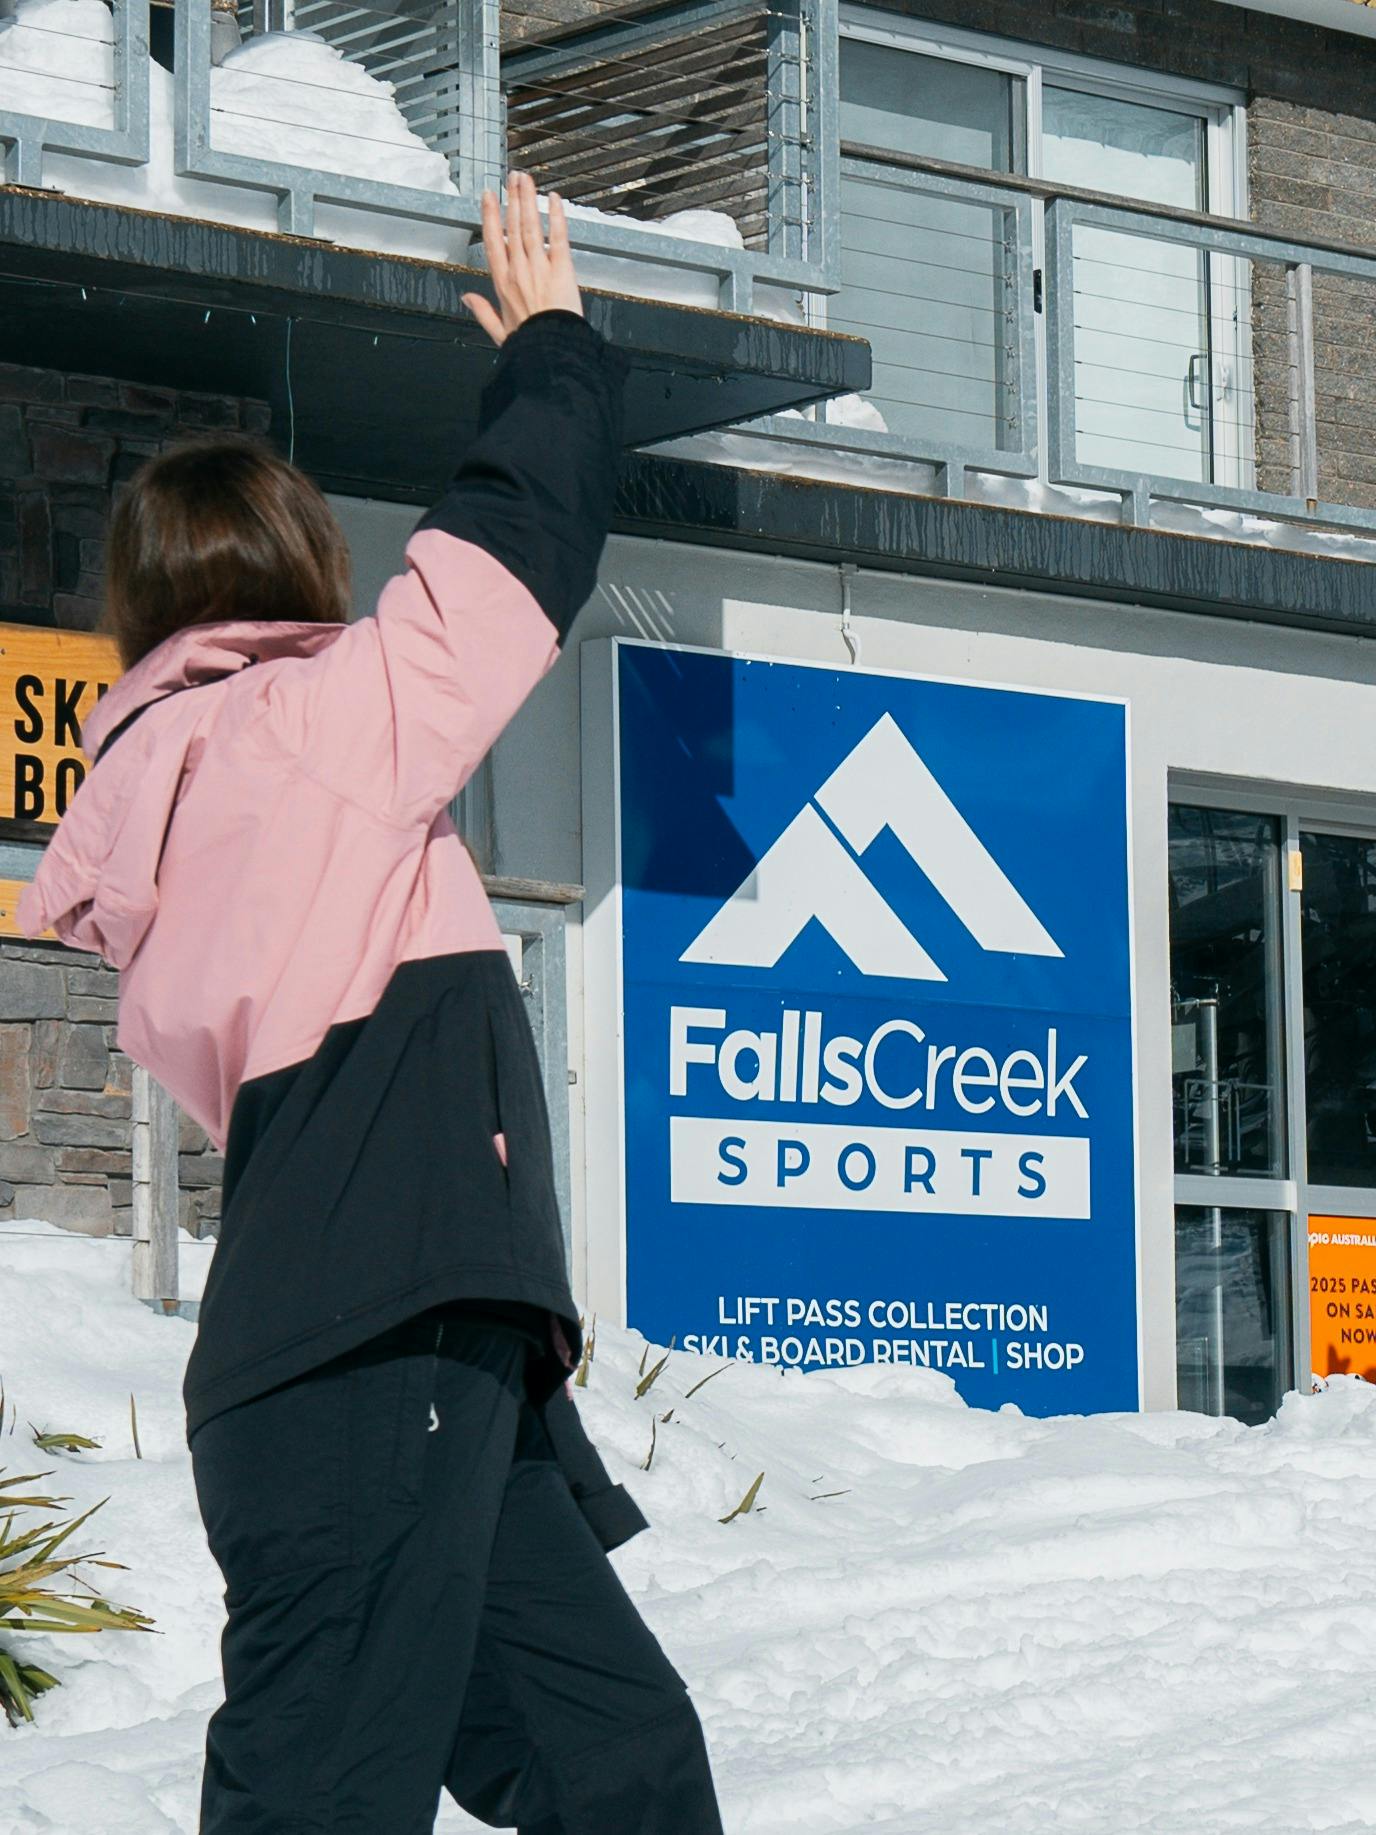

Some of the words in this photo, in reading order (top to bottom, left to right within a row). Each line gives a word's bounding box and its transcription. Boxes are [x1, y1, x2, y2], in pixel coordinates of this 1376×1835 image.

[14, 674, 108, 749] SK
[669, 1005, 1090, 1119] FallsCreek
[716, 1135, 1048, 1199] SPORTS
[1311, 1276, 1346, 1293] 2025
[718, 1296, 779, 1325] LIFT
[787, 1298, 861, 1327] PASS
[868, 1301, 1048, 1332] COLLECTION
[1326, 1302, 1350, 1319] ON
[683, 1334, 728, 1359] SKI
[735, 1335, 755, 1363] &
[761, 1336, 865, 1366] BOARD
[873, 1338, 984, 1368] RENTAL
[1006, 1342, 1084, 1370] SHOP
